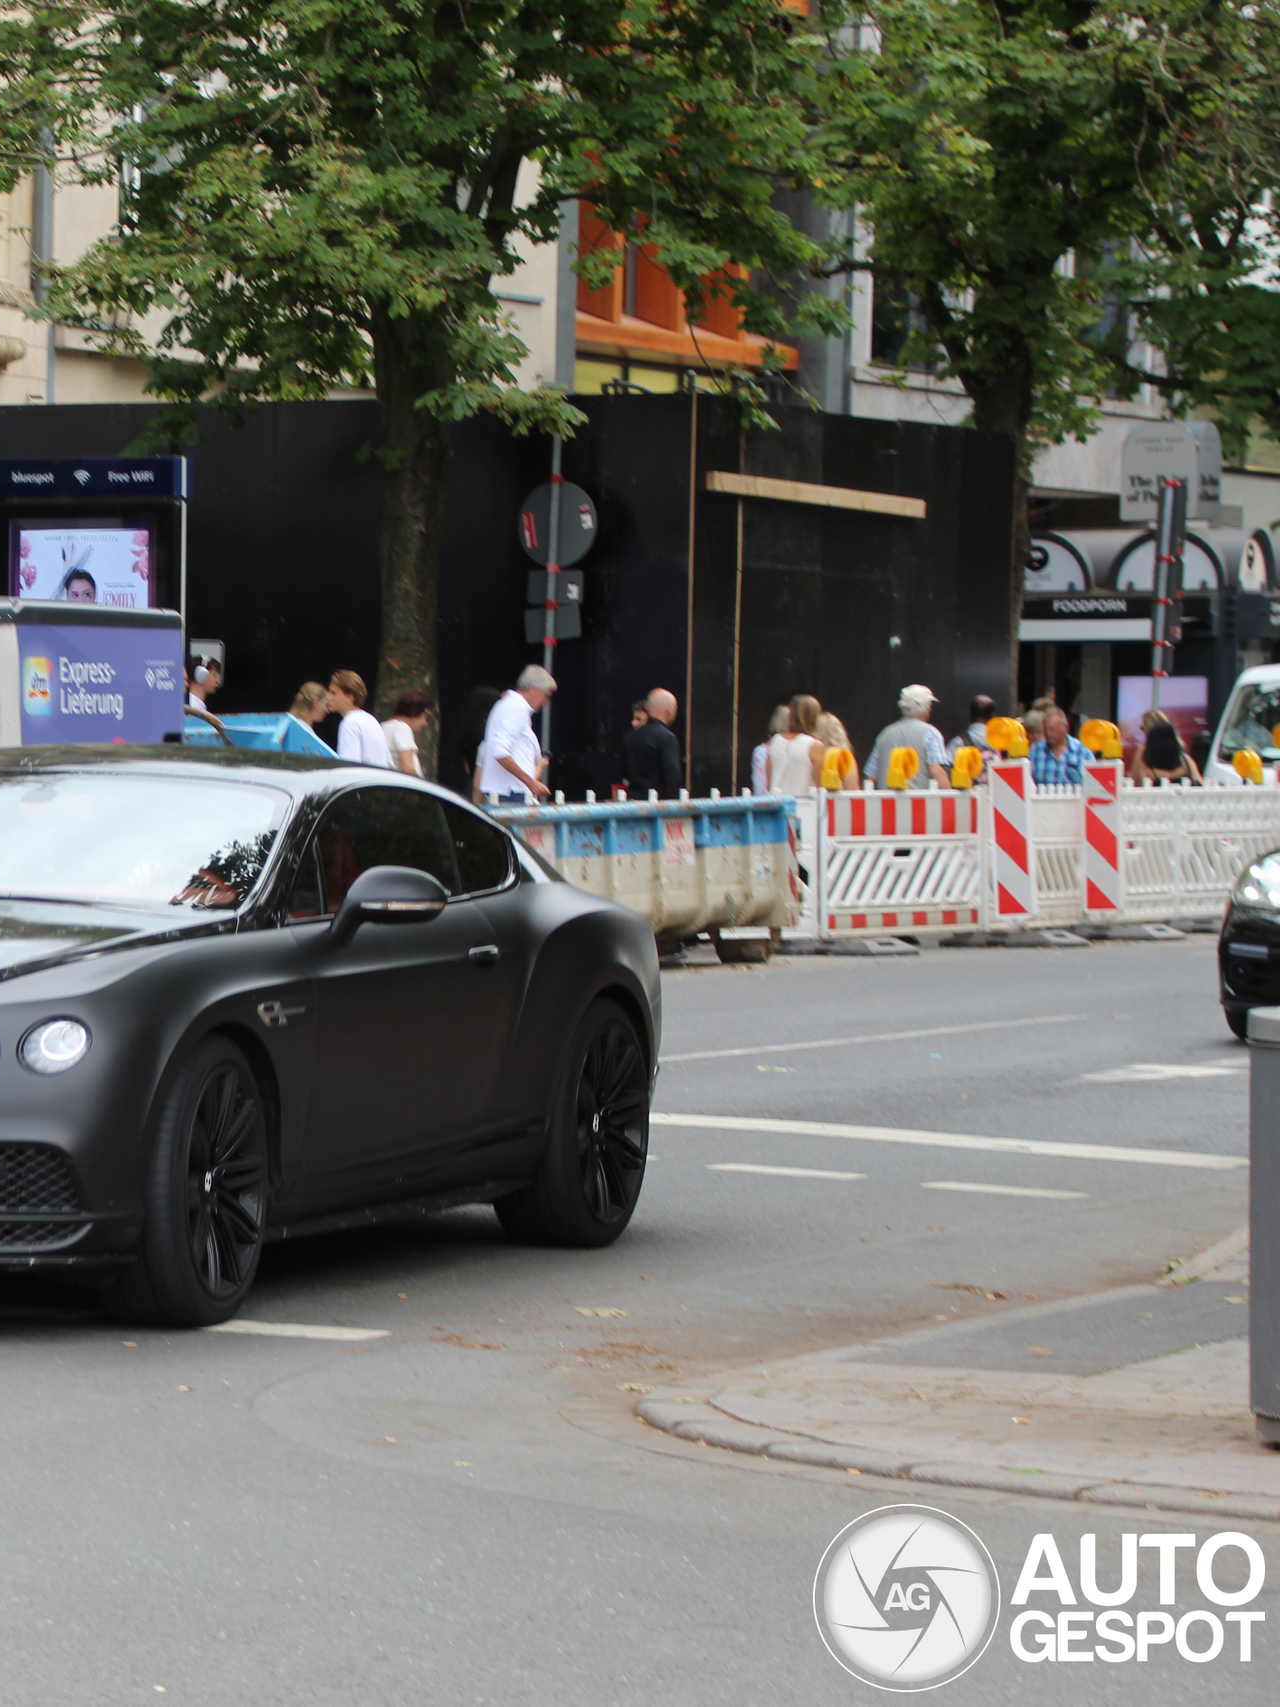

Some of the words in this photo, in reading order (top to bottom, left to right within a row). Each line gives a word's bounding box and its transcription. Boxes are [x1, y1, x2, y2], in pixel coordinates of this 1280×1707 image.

[11, 470, 55, 485] bluespot
[108, 470, 130, 483] Free
[1053, 599, 1127, 612] FOODPORN
[59, 656, 117, 688] Express-
[60, 687, 124, 720] Lieferung
